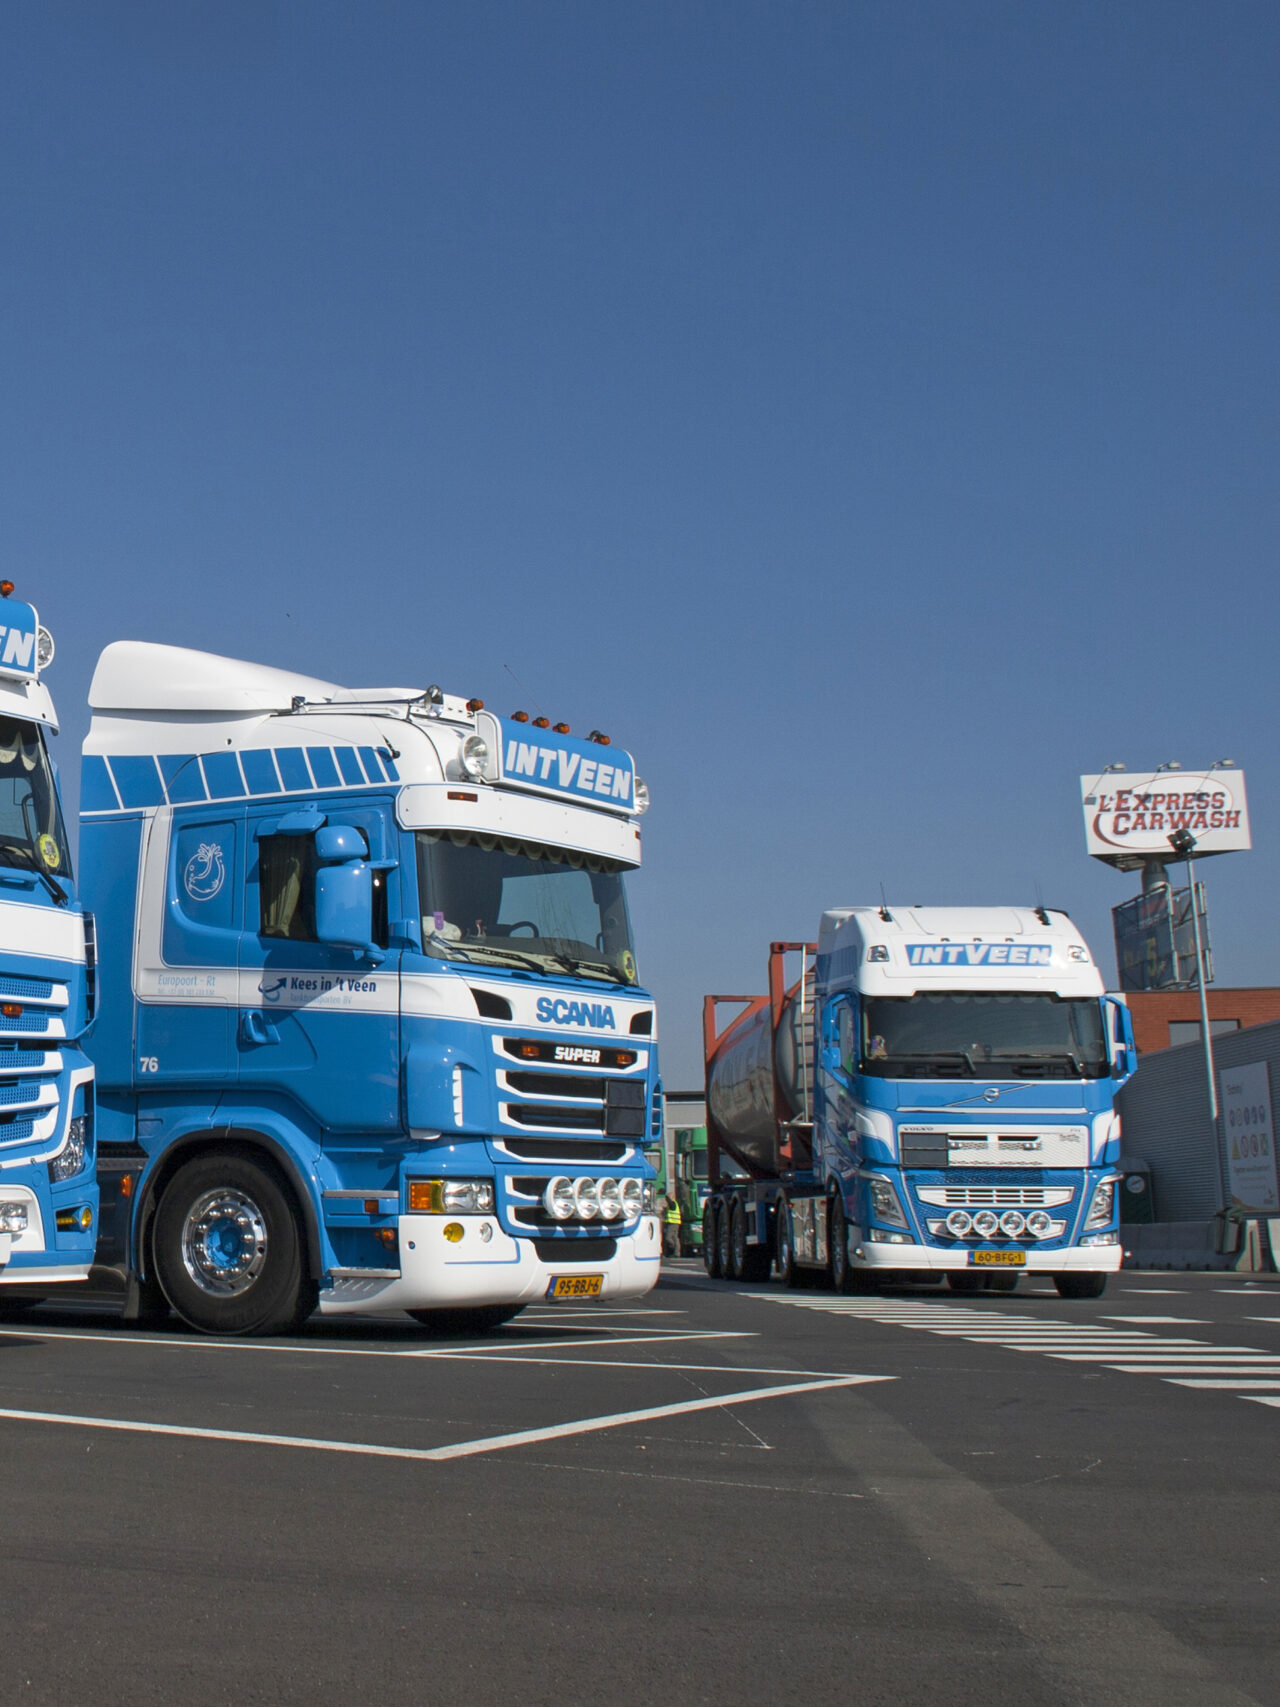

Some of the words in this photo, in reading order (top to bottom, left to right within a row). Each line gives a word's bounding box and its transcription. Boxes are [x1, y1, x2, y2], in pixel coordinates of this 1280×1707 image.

[505, 740, 631, 800] INTVEEN
[911, 945, 1050, 965] INTVEEN
[290, 976, 317, 990] Kees
[320, 976, 332, 991] in
[335, 977, 345, 991] 't
[347, 979, 377, 992] Veen
[536, 997, 616, 1030] SCANIA
[554, 1046, 601, 1064] SUPER
[139, 1057, 159, 1073] 76
[558, 1279, 600, 1294] 95-BBJ-6
